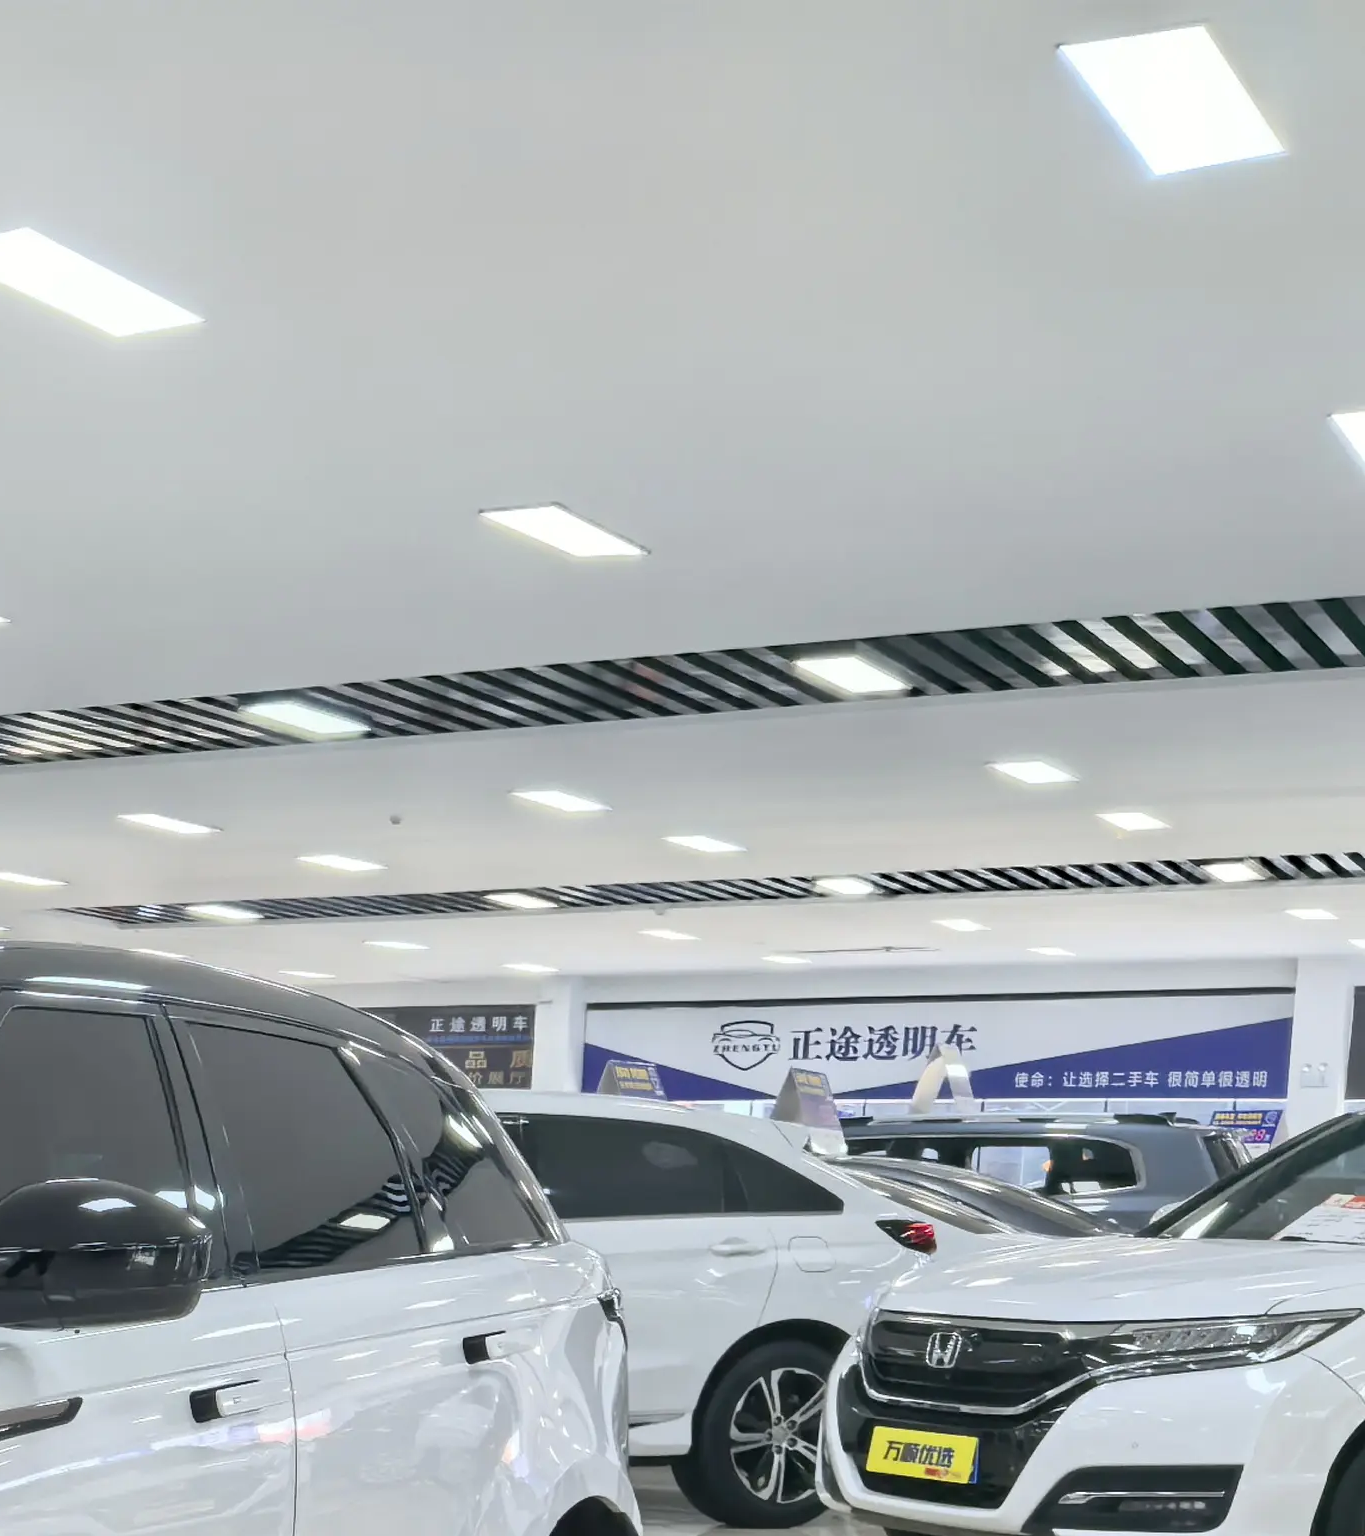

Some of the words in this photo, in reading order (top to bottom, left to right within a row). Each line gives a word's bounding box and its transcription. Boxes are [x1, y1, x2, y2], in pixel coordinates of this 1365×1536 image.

[429, 1016, 529, 1032] 正途透明车
[788, 1024, 977, 1061] 正途透明车
[1168, 1071, 1268, 1088] 很简单很透明
